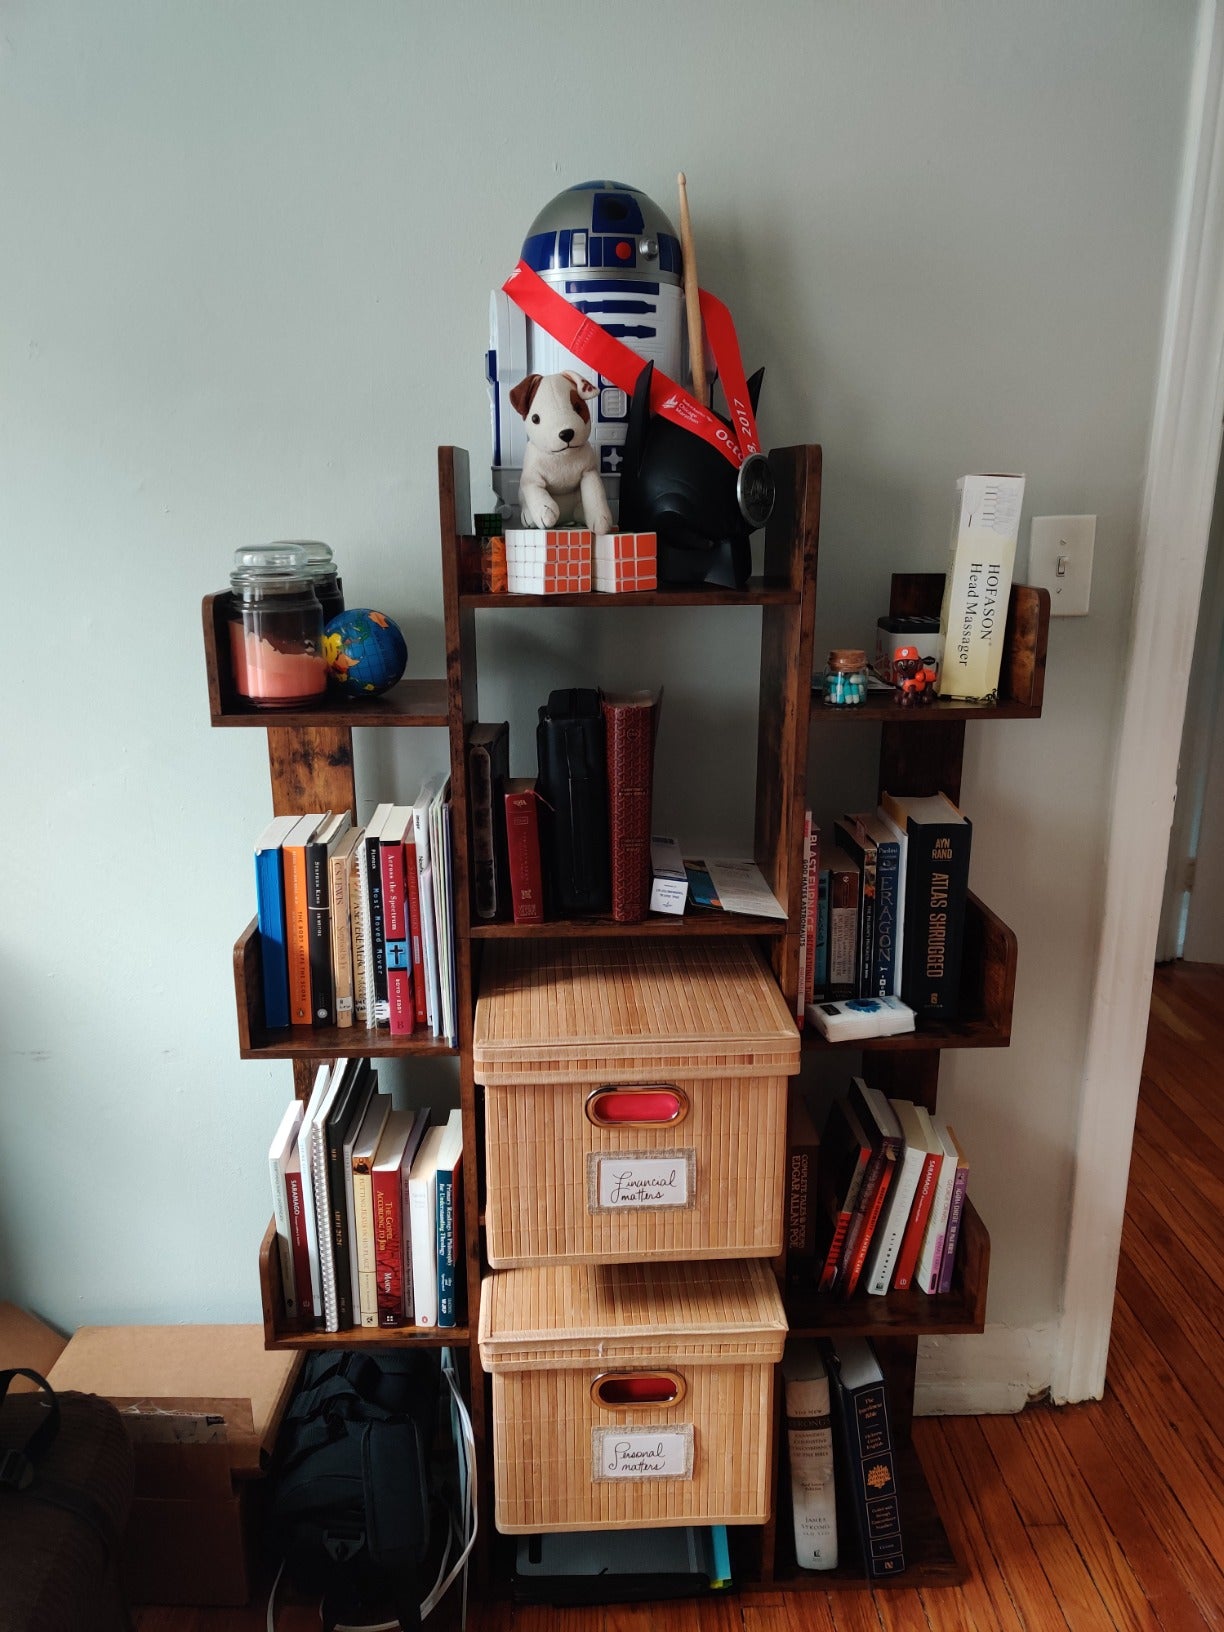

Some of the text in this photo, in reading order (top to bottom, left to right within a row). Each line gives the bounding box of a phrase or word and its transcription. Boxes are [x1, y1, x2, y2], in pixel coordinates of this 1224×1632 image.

[675, 407, 699, 425] Marathon
[678, 403, 698, 419] Chicago
[734, 398, 752, 437] 2017
[715, 429, 745, 462] Octo
[958, 562, 983, 667] Head Massager
[981, 563, 1001, 640] HOFASON
[931, 848, 953, 860] RAND
[935, 838, 951, 849] AYN
[387, 853, 396, 880] Across
[335, 876, 344, 905] LEWIS
[801, 876, 809, 898] HATES
[806, 833, 818, 934] BLAST FURNACE
[388, 894, 399, 931] Spectrum
[799, 900, 808, 947] ASTRONAUTS
[878, 876, 895, 962] ERAGON
[926, 872, 950, 978] ATLAS SHRUGGED
[296, 925, 304, 943] BODY
[372, 887, 384, 975] Most Moved Mover
[297, 945, 305, 964] KEEPS
[299, 980, 307, 1001] SCORE
[395, 999, 403, 1014] EDDY
[611, 1169, 678, 1204] Financial
[800, 1154, 808, 1193] COMPLETE
[922, 1159, 936, 1195] SARAMAGO
[290, 1179, 301, 1216] SARAMAGO
[444, 1183, 452, 1204] Primary
[621, 1187, 665, 1203] matters
[789, 1155, 800, 1248] EDGAR ALLAN POE
[376, 1190, 385, 1250] ACCORDING TO JOB
[384, 1202, 392, 1216] THE
[445, 1238, 453, 1266] Philosophy
[860, 1233, 870, 1251] JAMES
[853, 1259, 862, 1273] CAIN
[384, 1272, 392, 1293] MASON
[608, 1441, 666, 1471] Personal
[621, 1459, 666, 1473] matters
